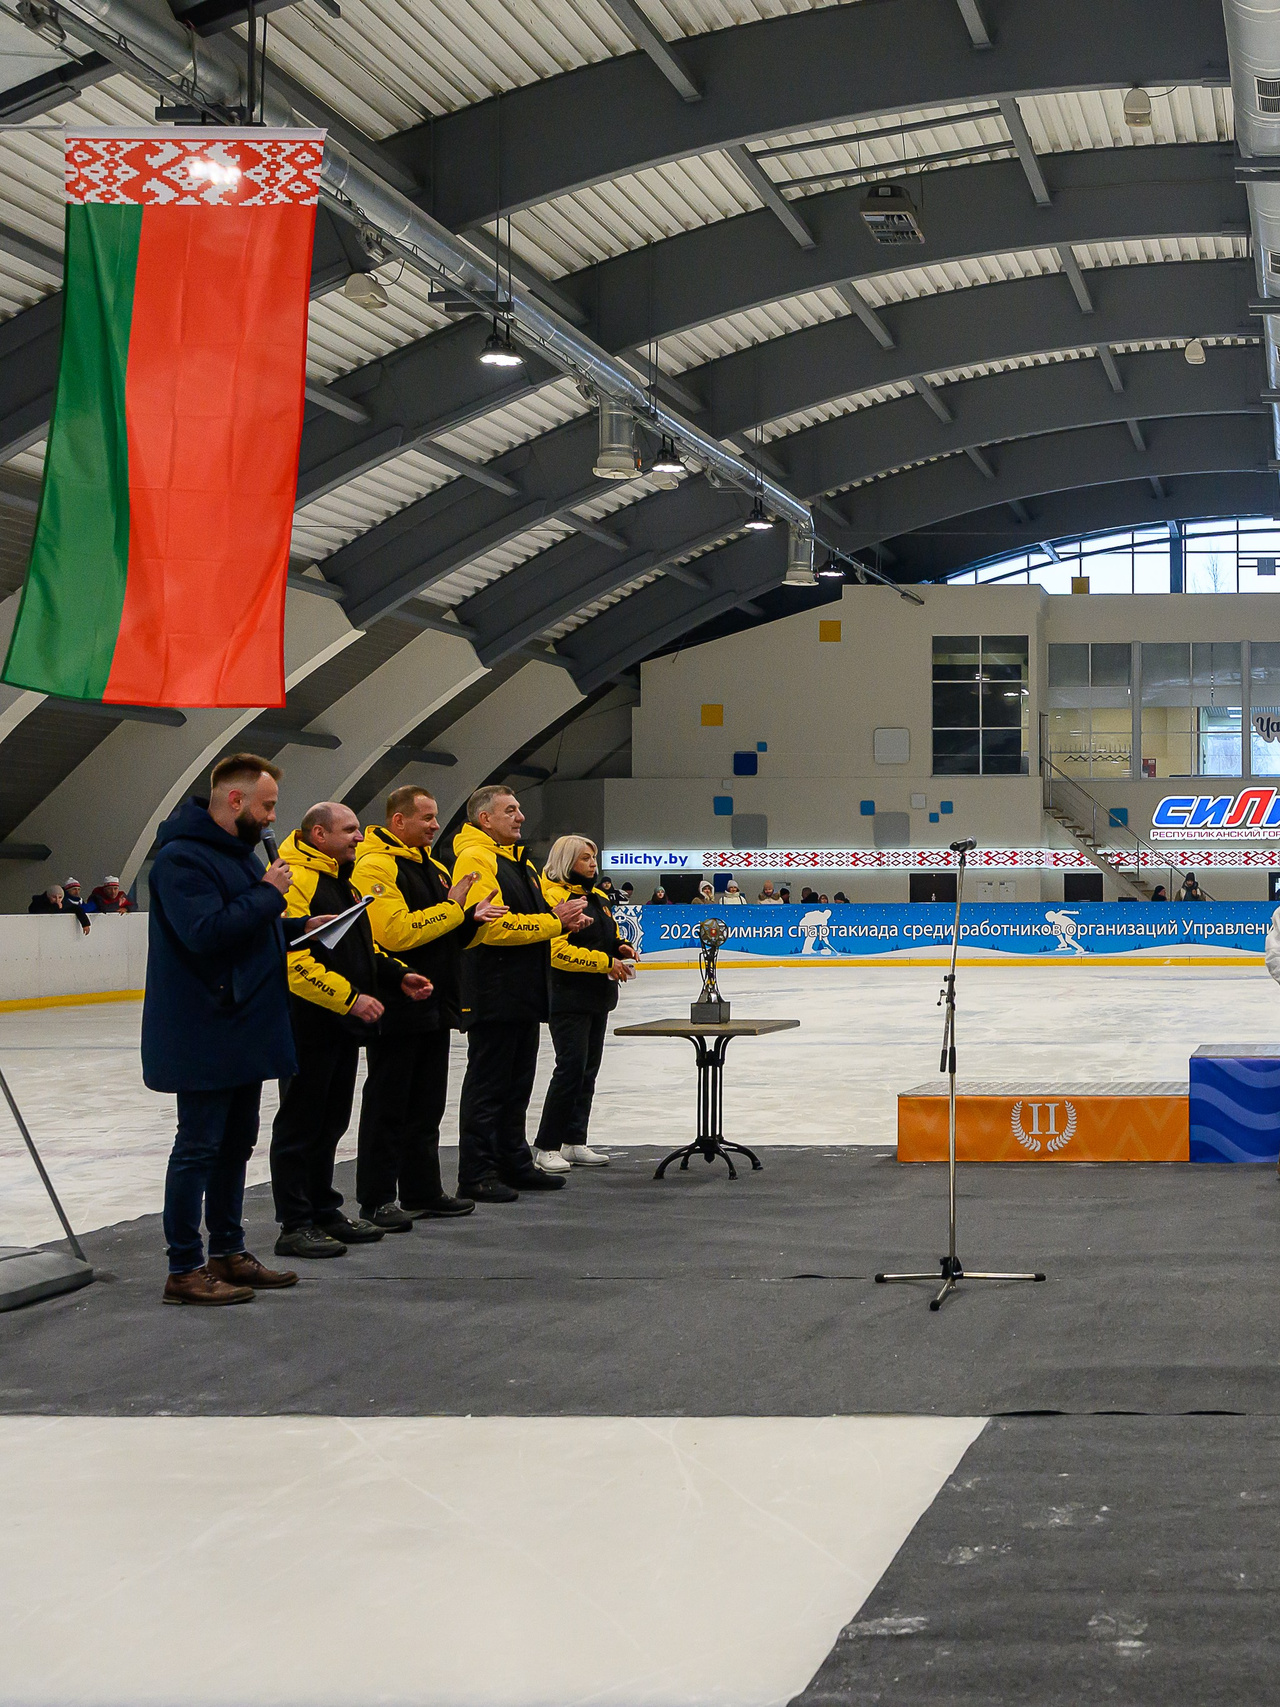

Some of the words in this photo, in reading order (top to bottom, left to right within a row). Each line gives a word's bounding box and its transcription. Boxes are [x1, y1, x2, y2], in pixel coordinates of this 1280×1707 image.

[1152, 828, 1260, 838] РЕСПУБЛИКАНСКИЙ
[611, 853, 688, 866] silichy.by
[660, 924, 701, 939] 2026
[728, 925, 783, 938] имняя
[788, 925, 898, 940] спартакиада
[903, 924, 954, 939] среди
[959, 919, 1061, 939] работников
[1065, 920, 1178, 939] организаций
[1182, 920, 1274, 938] Управлени
[556, 953, 598, 967] BELARUS
[294, 964, 336, 997] BELARUS
[1028, 1103, 1060, 1135] II
